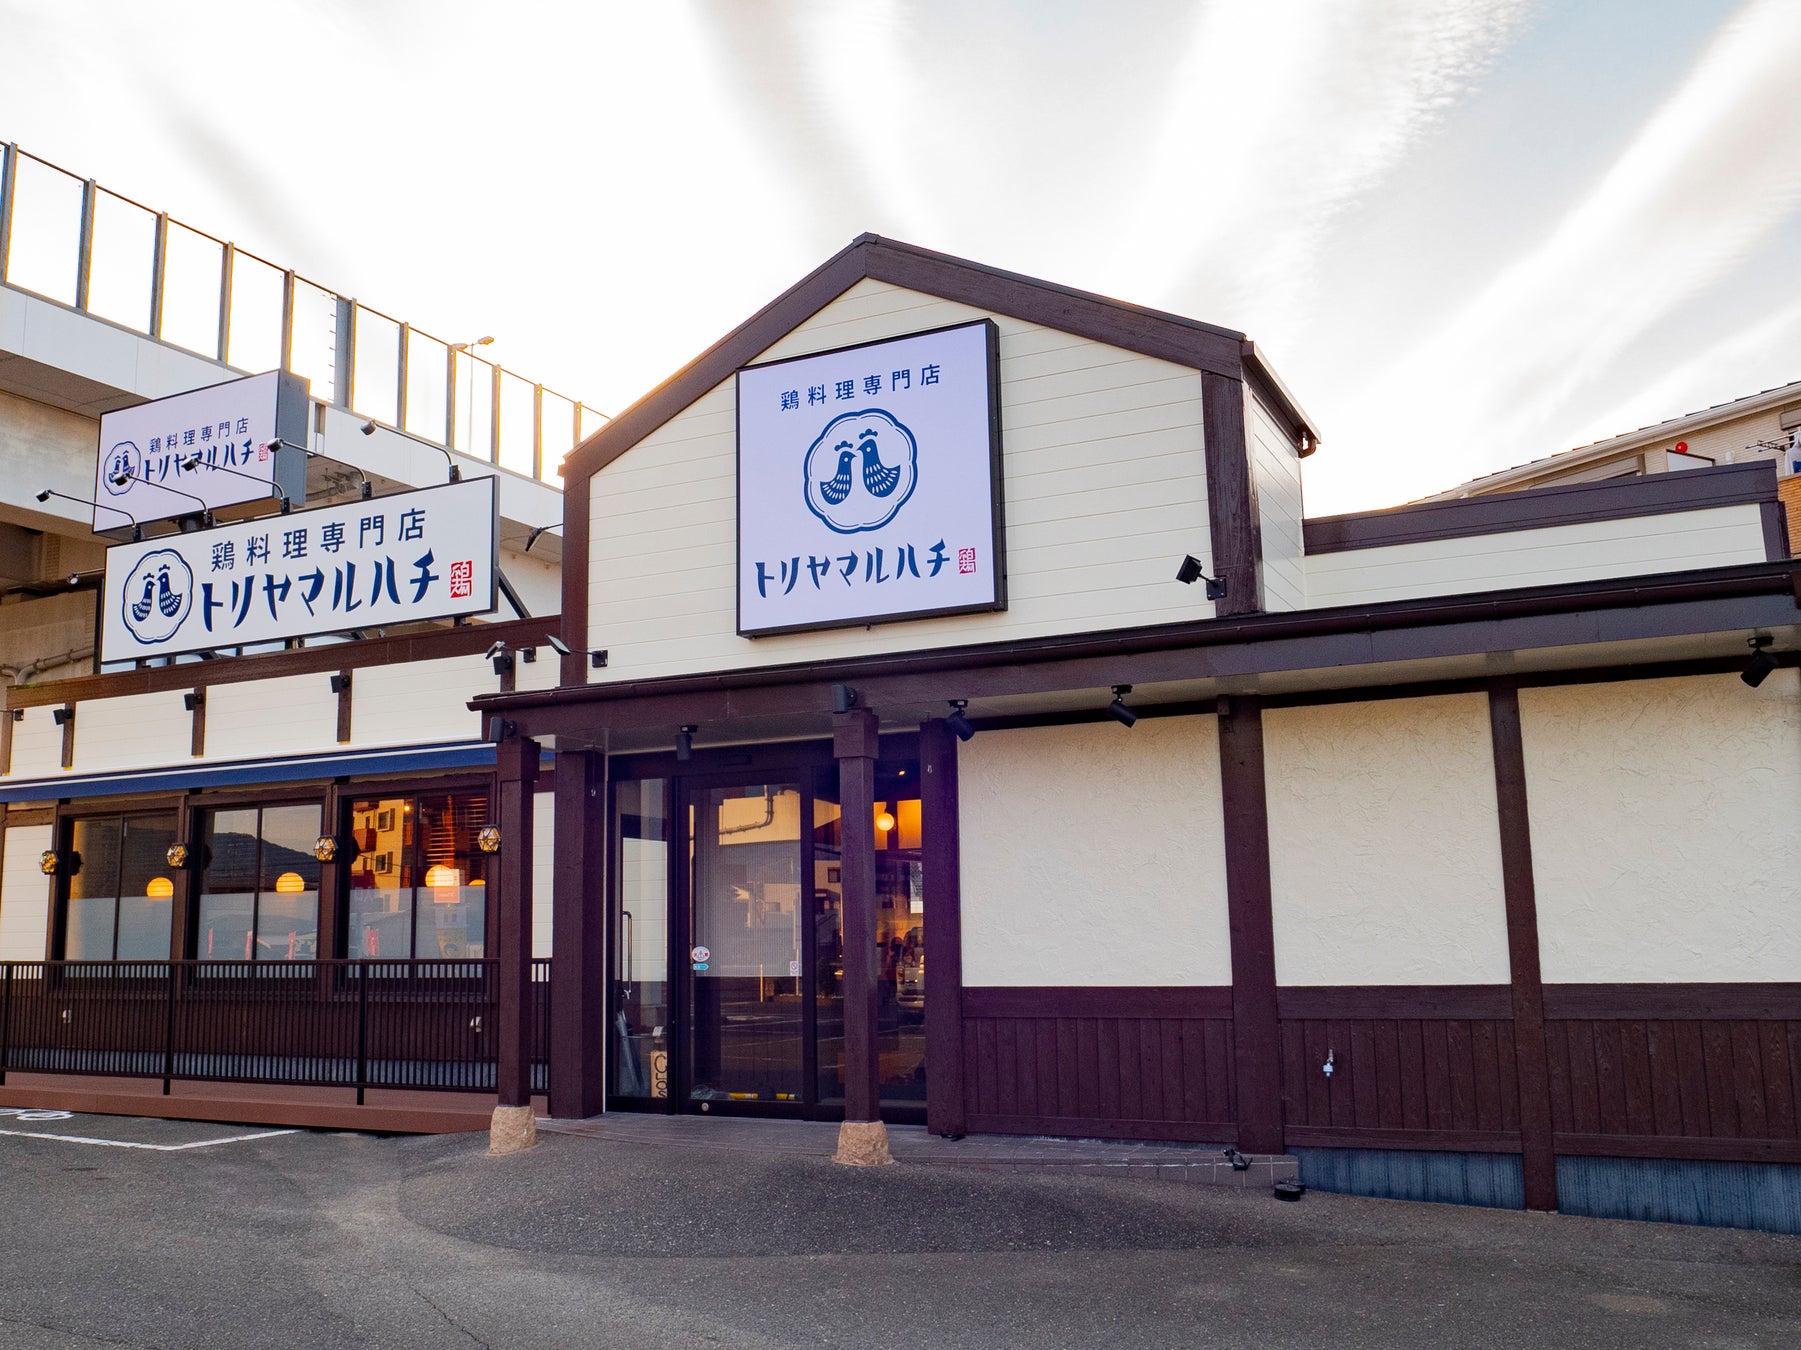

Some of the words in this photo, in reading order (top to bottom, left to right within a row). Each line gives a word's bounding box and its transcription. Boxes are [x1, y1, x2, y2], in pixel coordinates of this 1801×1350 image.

[780, 363, 941, 412] 鶏料理専門店
[149, 417, 249, 454] 鶏料理専門店
[211, 507, 426, 573] 鶏料理専門店
[754, 537, 950, 598] トリヤマルハチ
[202, 547, 440, 632] トリヤマルハチ
